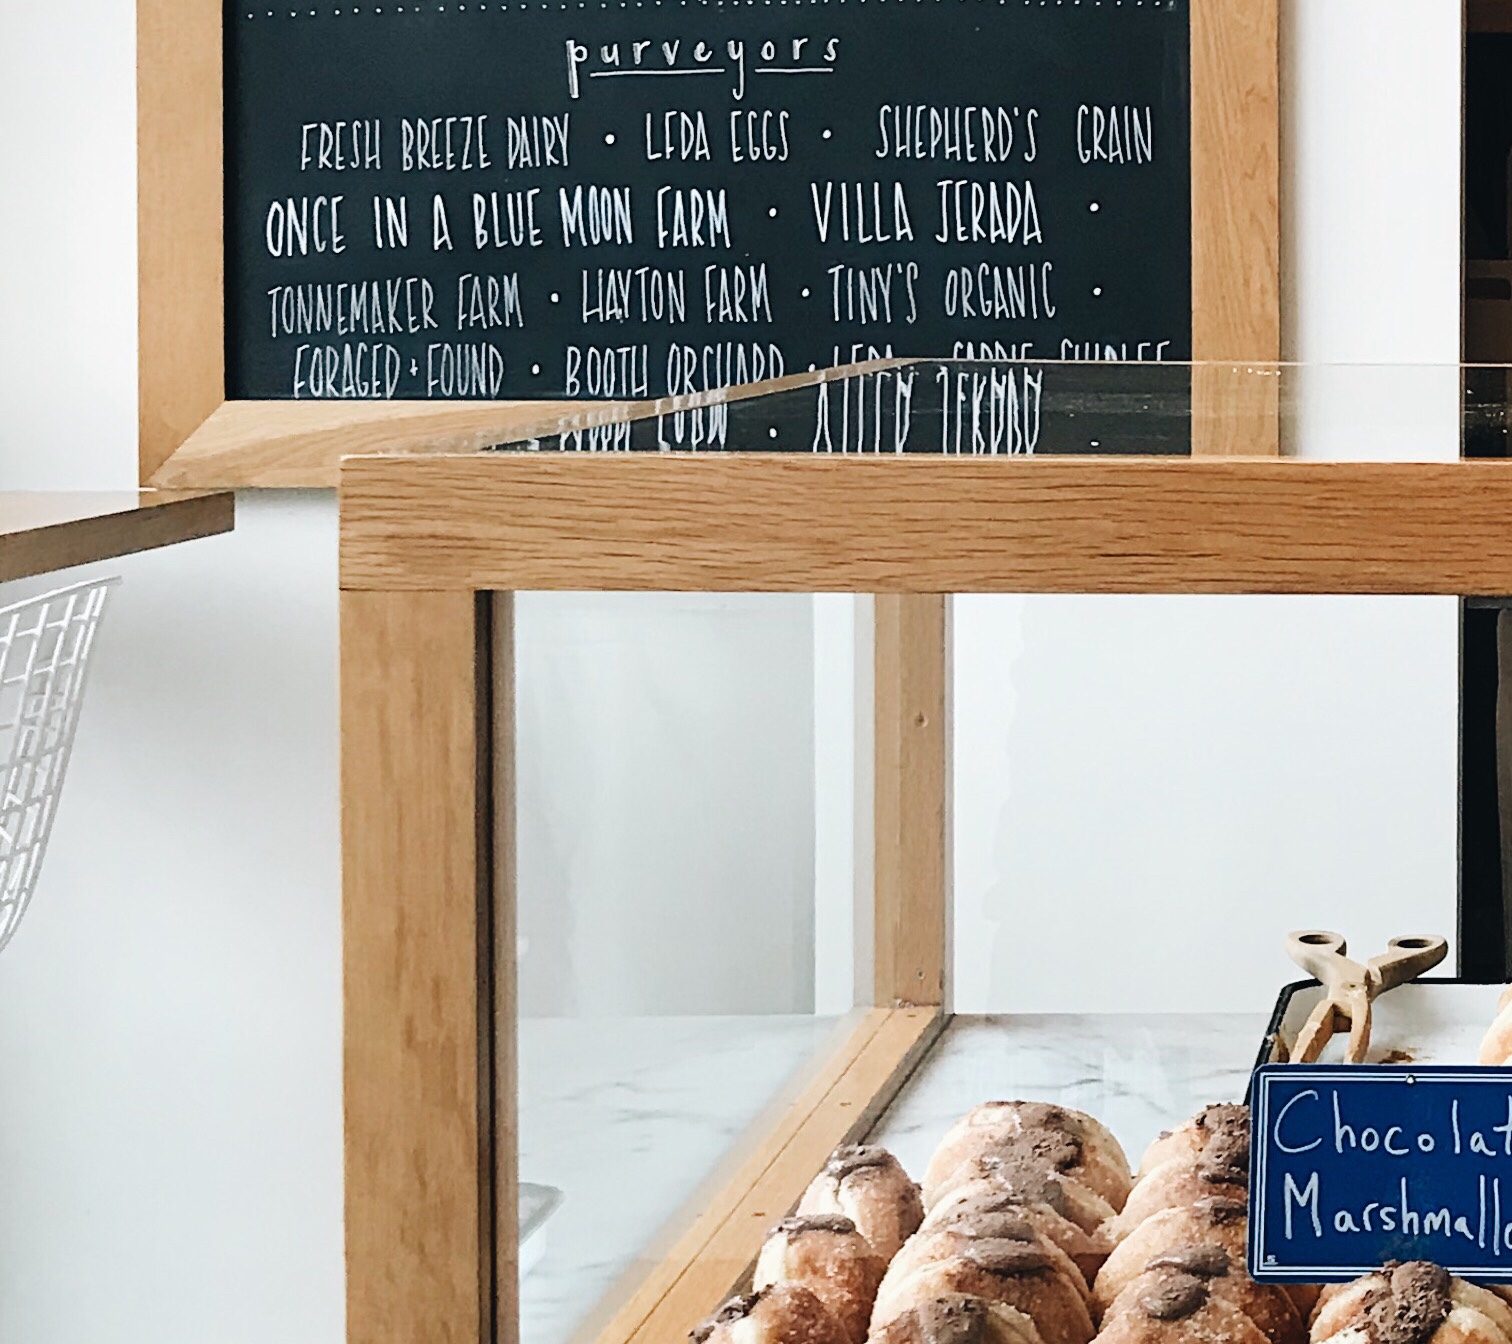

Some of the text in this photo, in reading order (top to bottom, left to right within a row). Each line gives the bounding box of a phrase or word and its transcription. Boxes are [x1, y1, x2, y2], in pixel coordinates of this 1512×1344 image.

[565, 37, 839, 101] purveyors
[301, 119, 381, 171] FRESH
[401, 114, 492, 171] BREEZE
[507, 112, 569, 170] DAIRY
[730, 109, 789, 163] EGGS
[875, 104, 1039, 163] SHEPHERD'S
[1077, 104, 1152, 164] GRAIN
[266, 179, 1043, 257] ONCE IN A BLUE MOON FARM VILLA JERADA
[267, 261, 1056, 338] TONNEMAKER FARM HAYTON FARM TINY'S ORGANIC
[293, 342, 400, 399] FORAGED
[409, 358, 419, 376] +
[427, 342, 504, 399] FOUND
[566, 344, 648, 397] BOOTH
